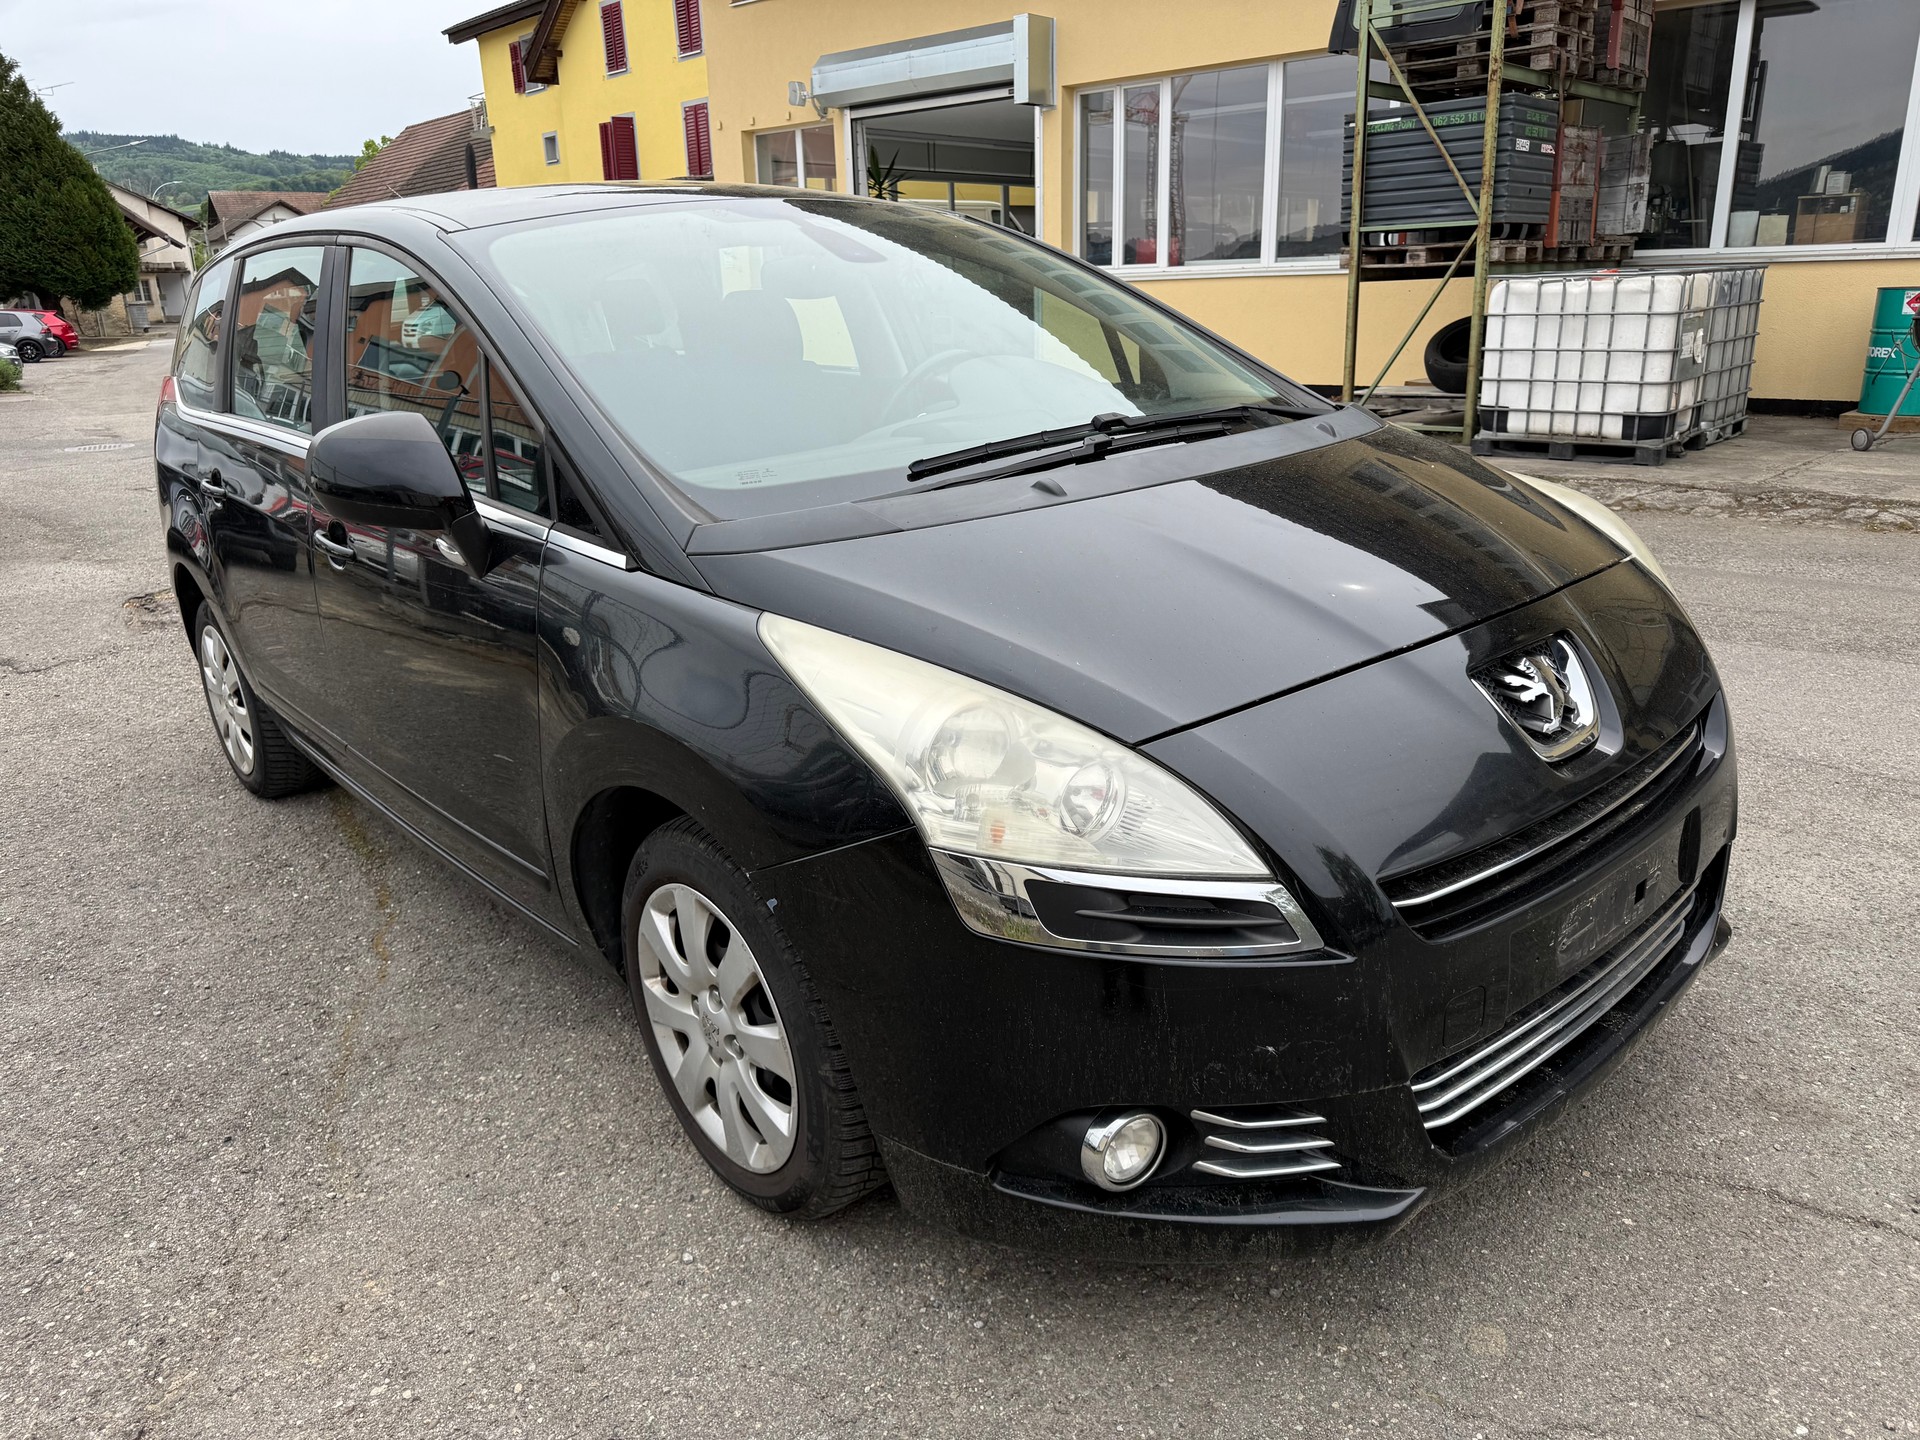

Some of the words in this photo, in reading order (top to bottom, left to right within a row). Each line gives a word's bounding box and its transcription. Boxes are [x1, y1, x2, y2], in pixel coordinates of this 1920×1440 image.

[1432, 116, 1448, 127] 062
[1450, 113, 1466, 125] 552
[1468, 111, 1478, 122] 18
